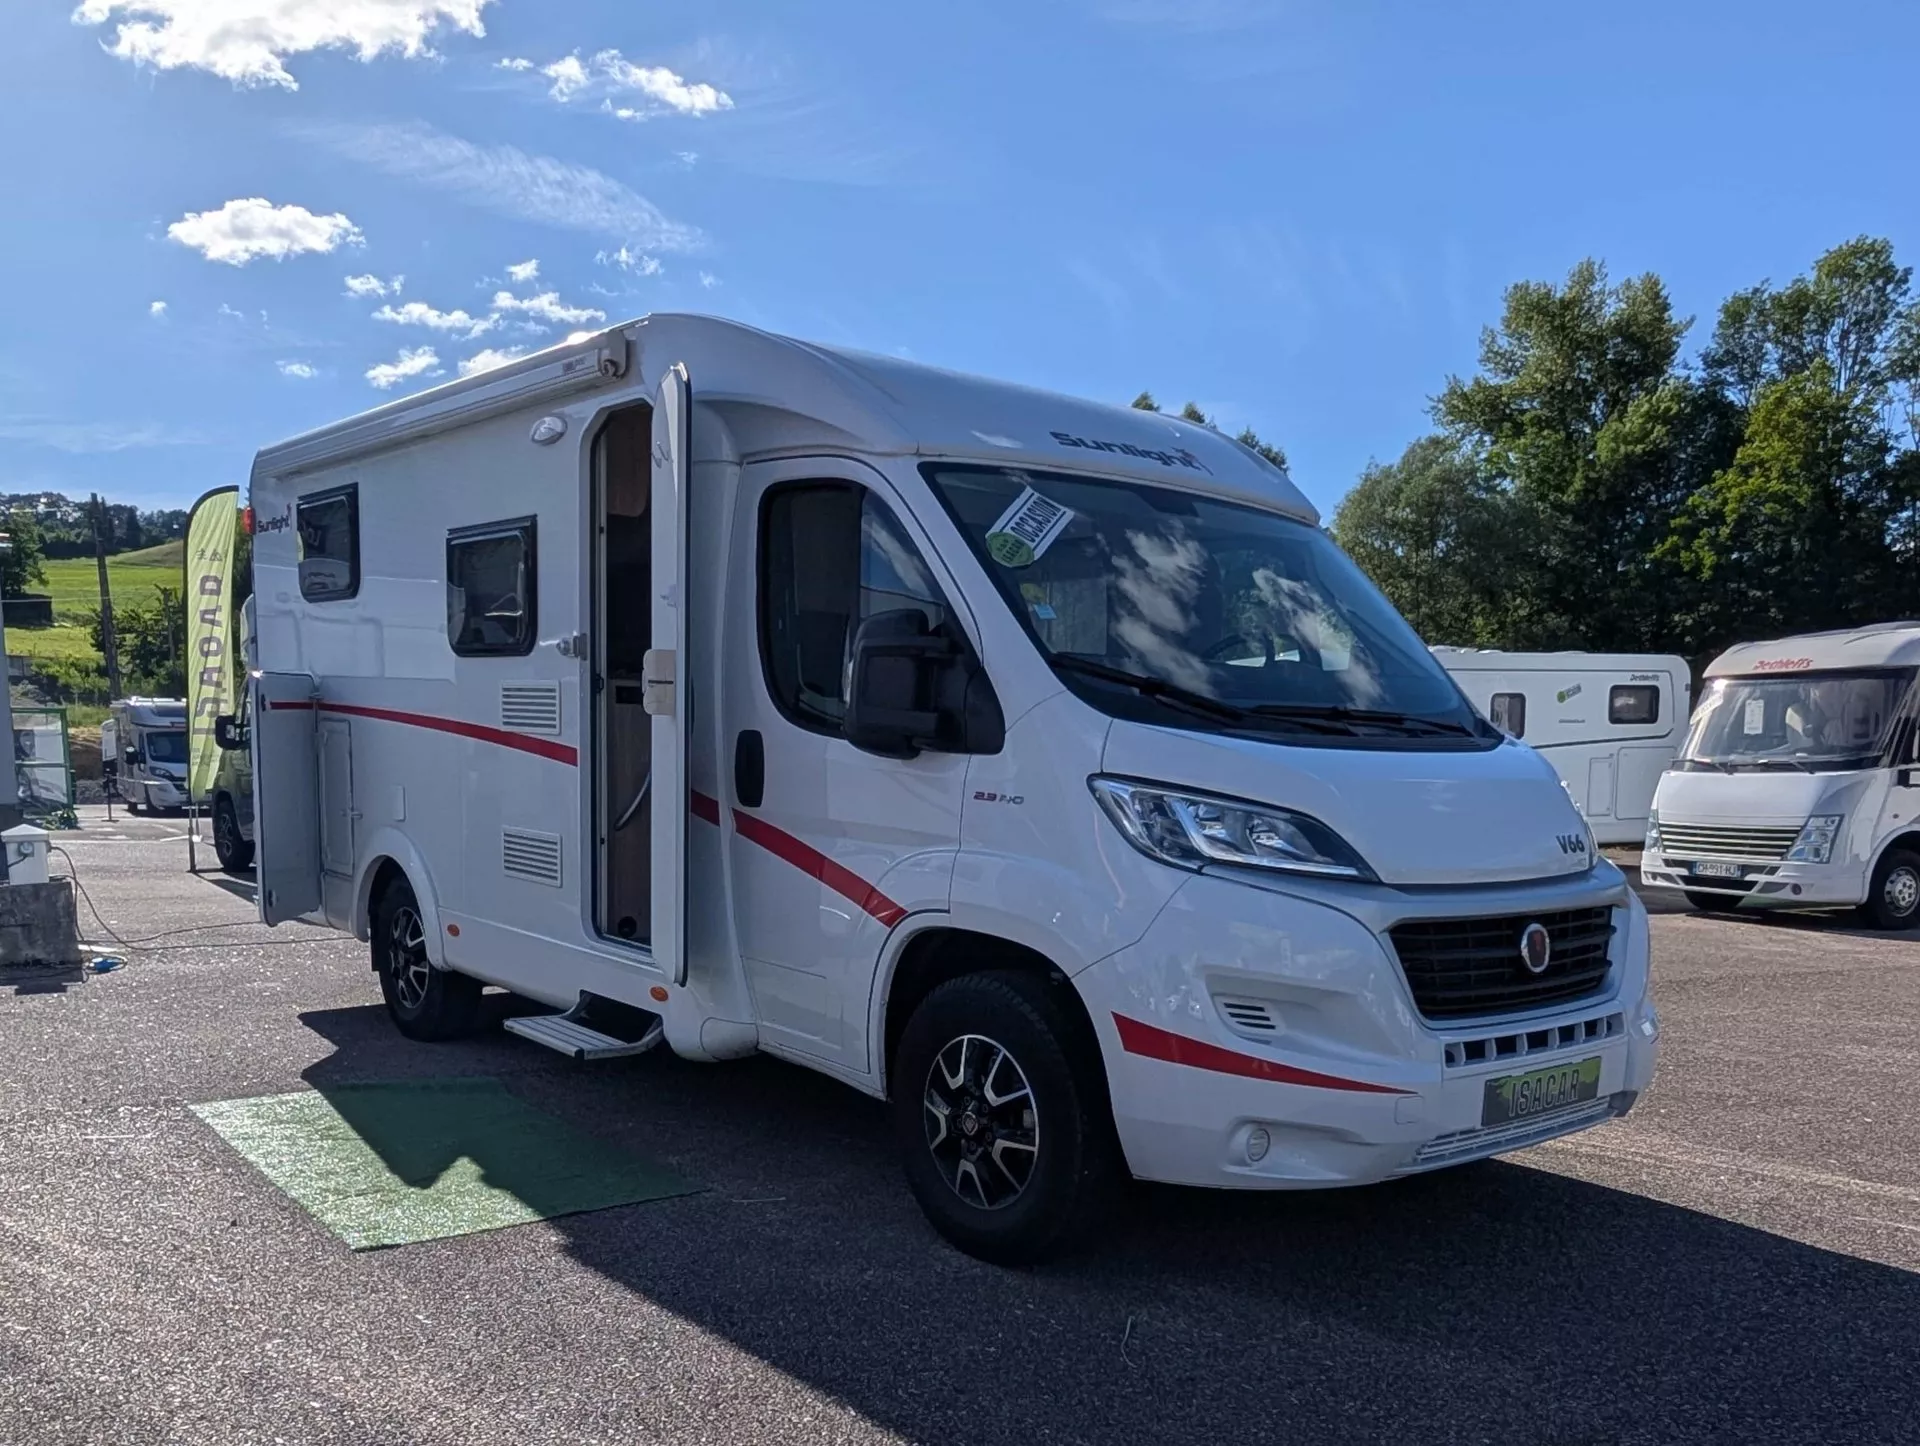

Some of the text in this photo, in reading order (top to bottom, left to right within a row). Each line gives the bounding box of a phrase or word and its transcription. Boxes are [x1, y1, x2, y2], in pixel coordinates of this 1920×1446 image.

[1049, 431, 1207, 472] Sunlight
[257, 509, 291, 533] Sunlight
[1010, 496, 1062, 543] OCCASION
[1753, 658, 1813, 670] Dethleffs
[1555, 834, 1585, 854] V66
[1508, 1069, 1580, 1118] ISACAR
